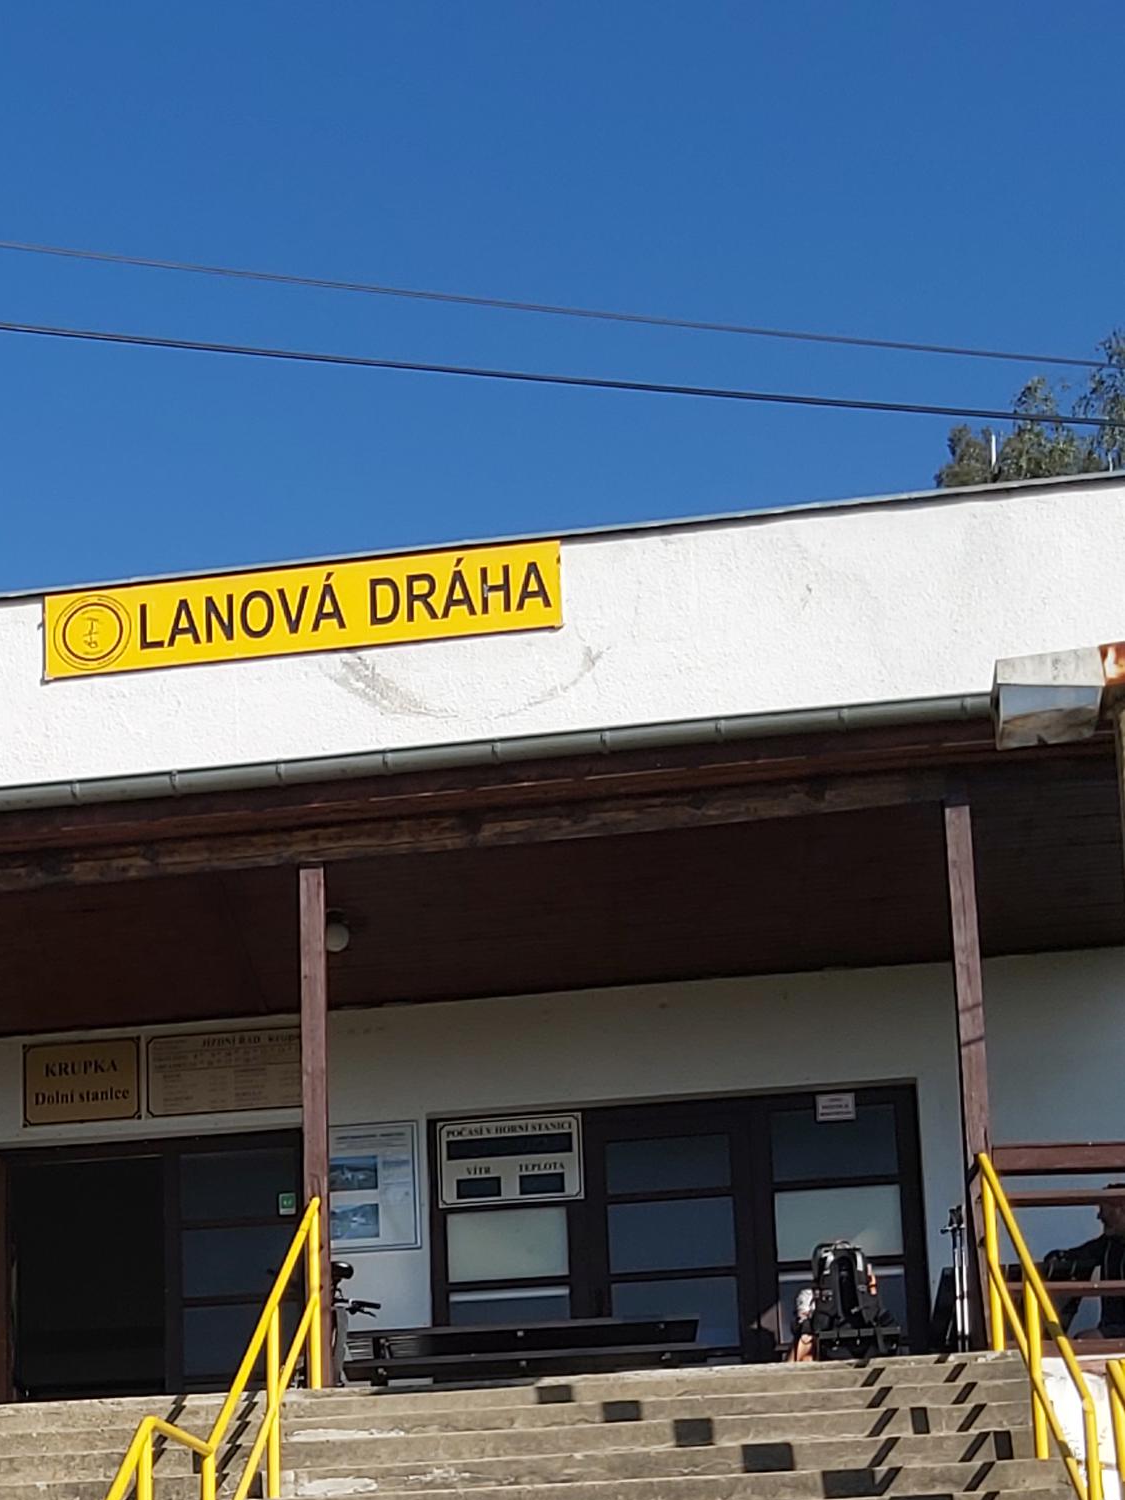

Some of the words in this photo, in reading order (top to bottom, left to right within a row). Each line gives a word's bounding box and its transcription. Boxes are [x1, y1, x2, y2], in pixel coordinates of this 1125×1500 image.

[138, 571, 347, 651] LANOVÁ
[369, 557, 552, 627] DRÁHA
[44, 1059, 118, 1077] KRUPKA
[34, 1088, 75, 1106] Dolní
[78, 1086, 130, 1103] stanice
[446, 1126, 483, 1139] POČASÍ
[484, 1126, 492, 1135] V
[495, 1122, 528, 1134] HORNÍ
[530, 1121, 572, 1131] STANICI
[466, 1164, 491, 1175] VÍTR
[519, 1161, 565, 1173] TEPLOTA
